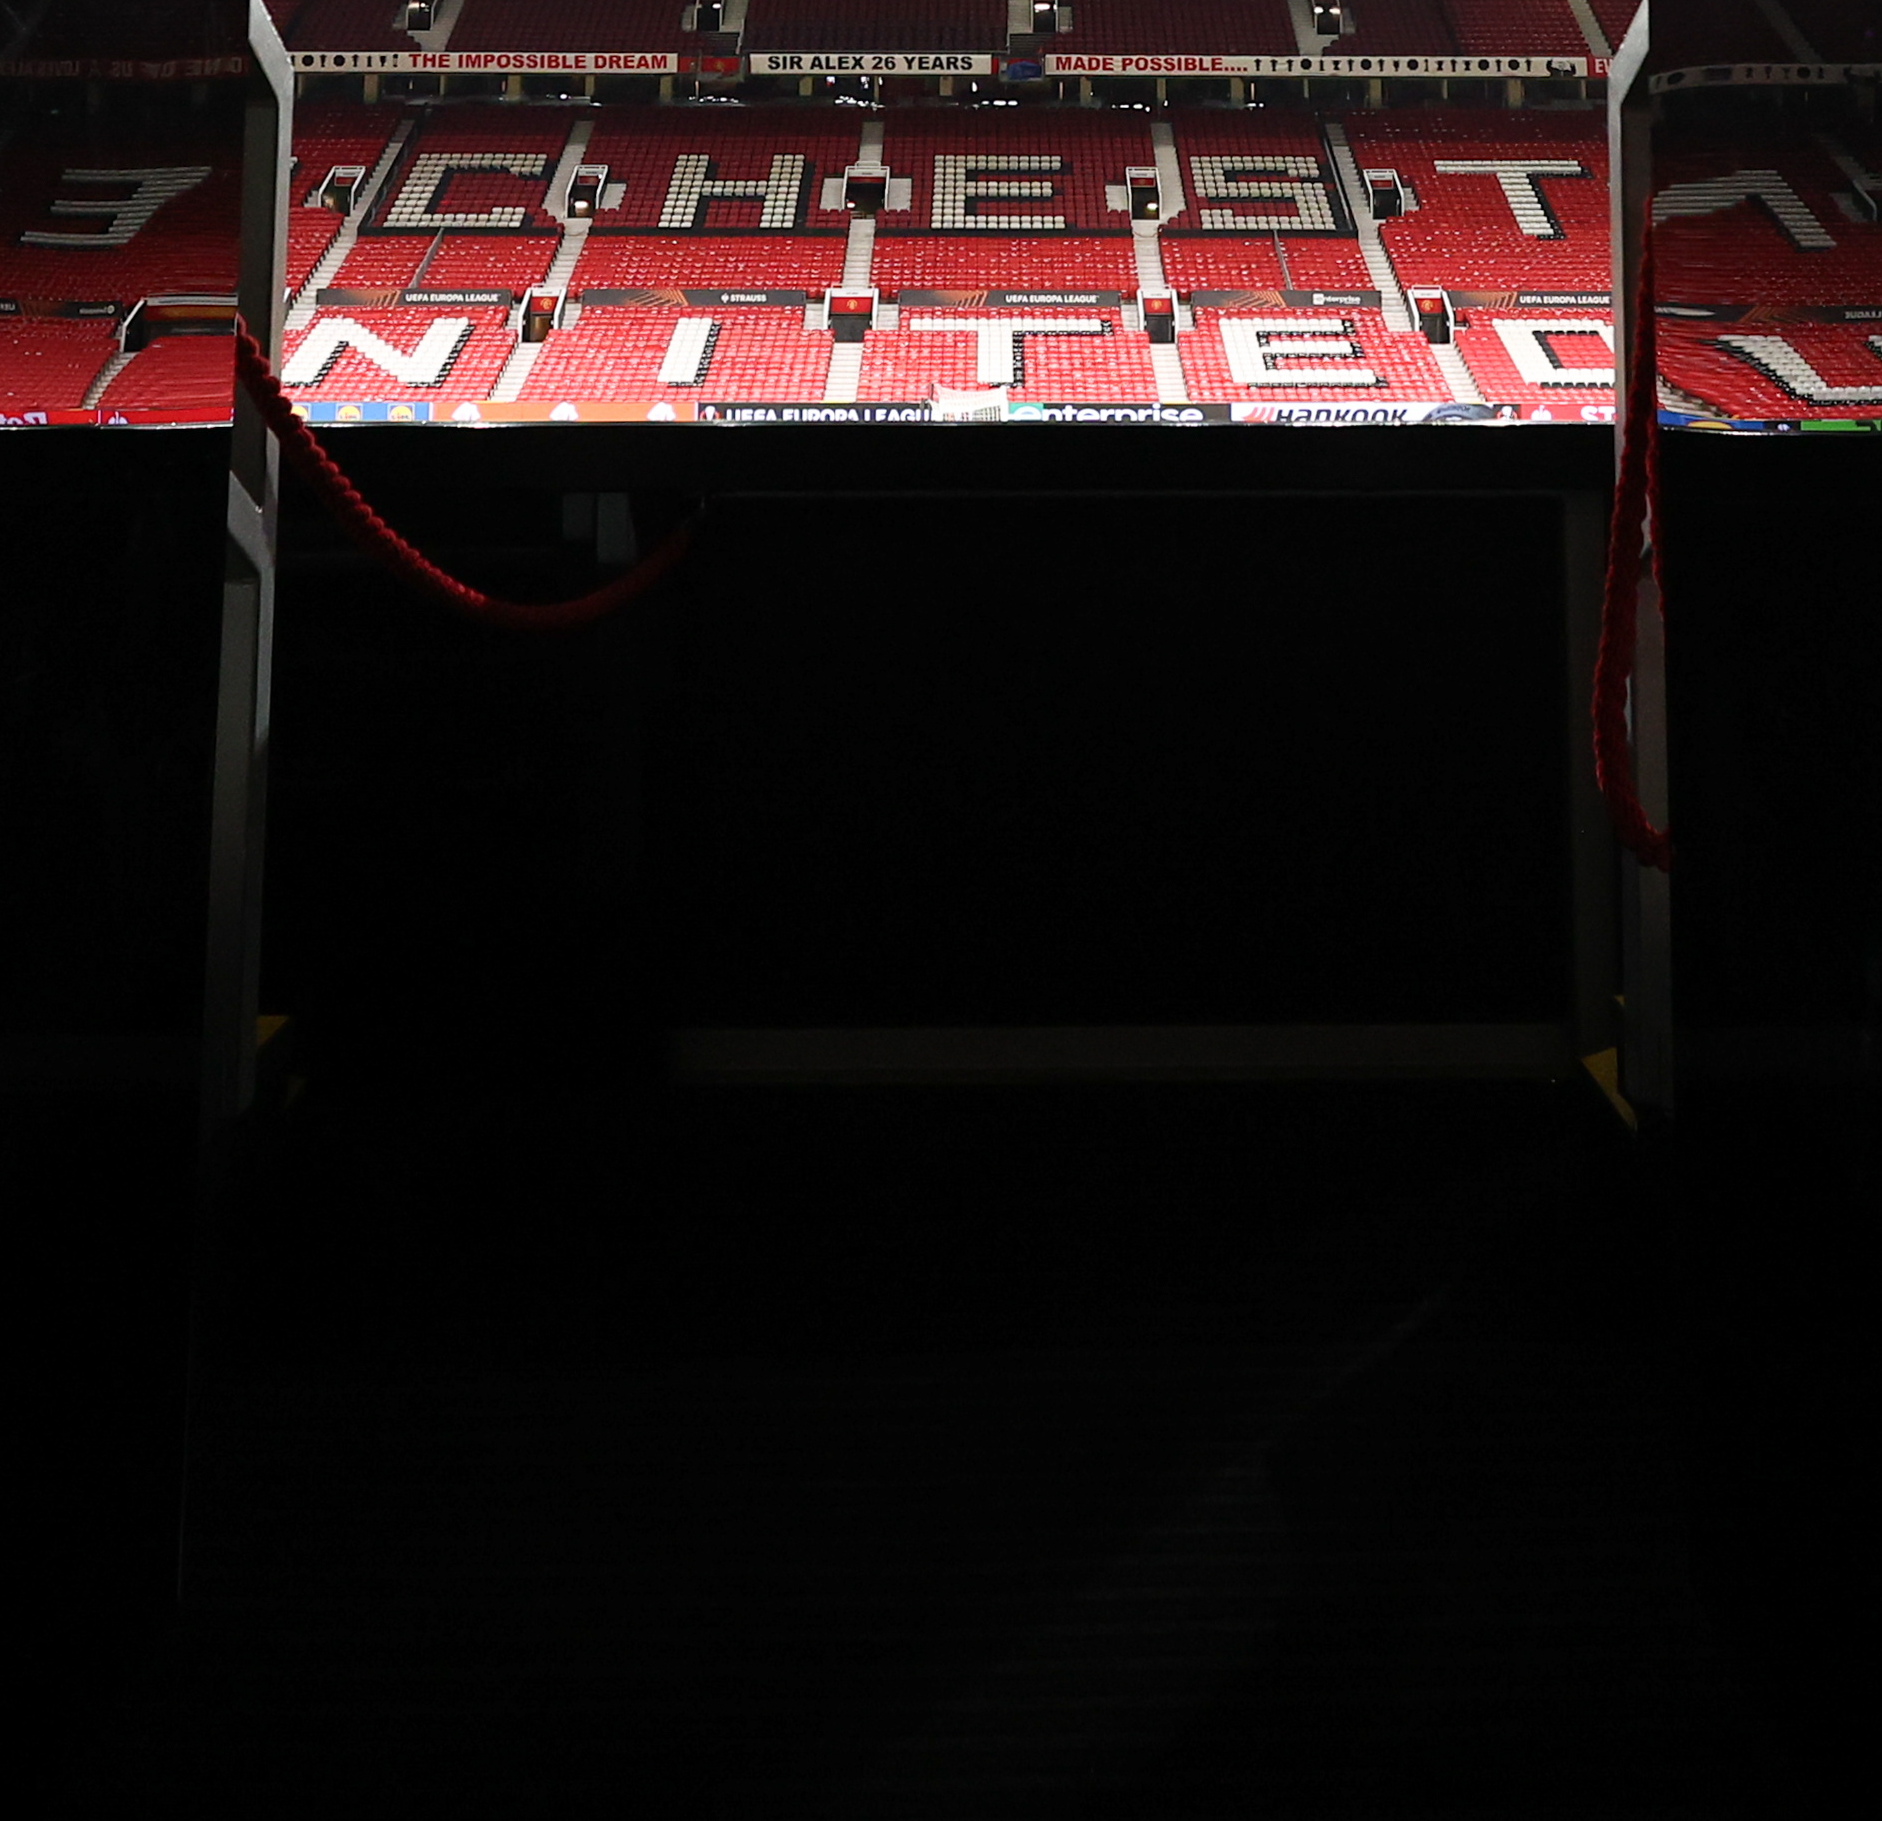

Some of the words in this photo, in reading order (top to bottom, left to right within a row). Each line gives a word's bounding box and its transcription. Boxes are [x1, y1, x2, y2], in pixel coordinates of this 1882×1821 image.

[409, 53, 451, 68] THE
[458, 54, 587, 69] IMPOSSIBLE
[594, 55, 668, 70] DREAM
[767, 55, 807, 70] SIR
[809, 55, 864, 70] ALEX
[871, 55, 897, 71] 26
[904, 56, 973, 71] YEARS
[1055, 56, 1115, 71] MADE
[405, 292, 428, 302] UEFA
[429, 292, 465, 302] EUROPA
[466, 292, 499, 302] LEAGUE
[730, 293, 767, 303] STRAUSS
[1005, 294, 1029, 304] UEFA
[1029, 294, 1063, 304] EUROPA
[1064, 294, 1098, 304] LEAGUE
[1519, 295, 1543, 304] UEFA
[1543, 295, 1577, 304] EUROPA
[1577, 295, 1610, 305] LEAGUE
[726, 408, 778, 421] UEFA
[782, 408, 860, 421] EUROPA
[1013, 403, 1204, 422] enterprise
